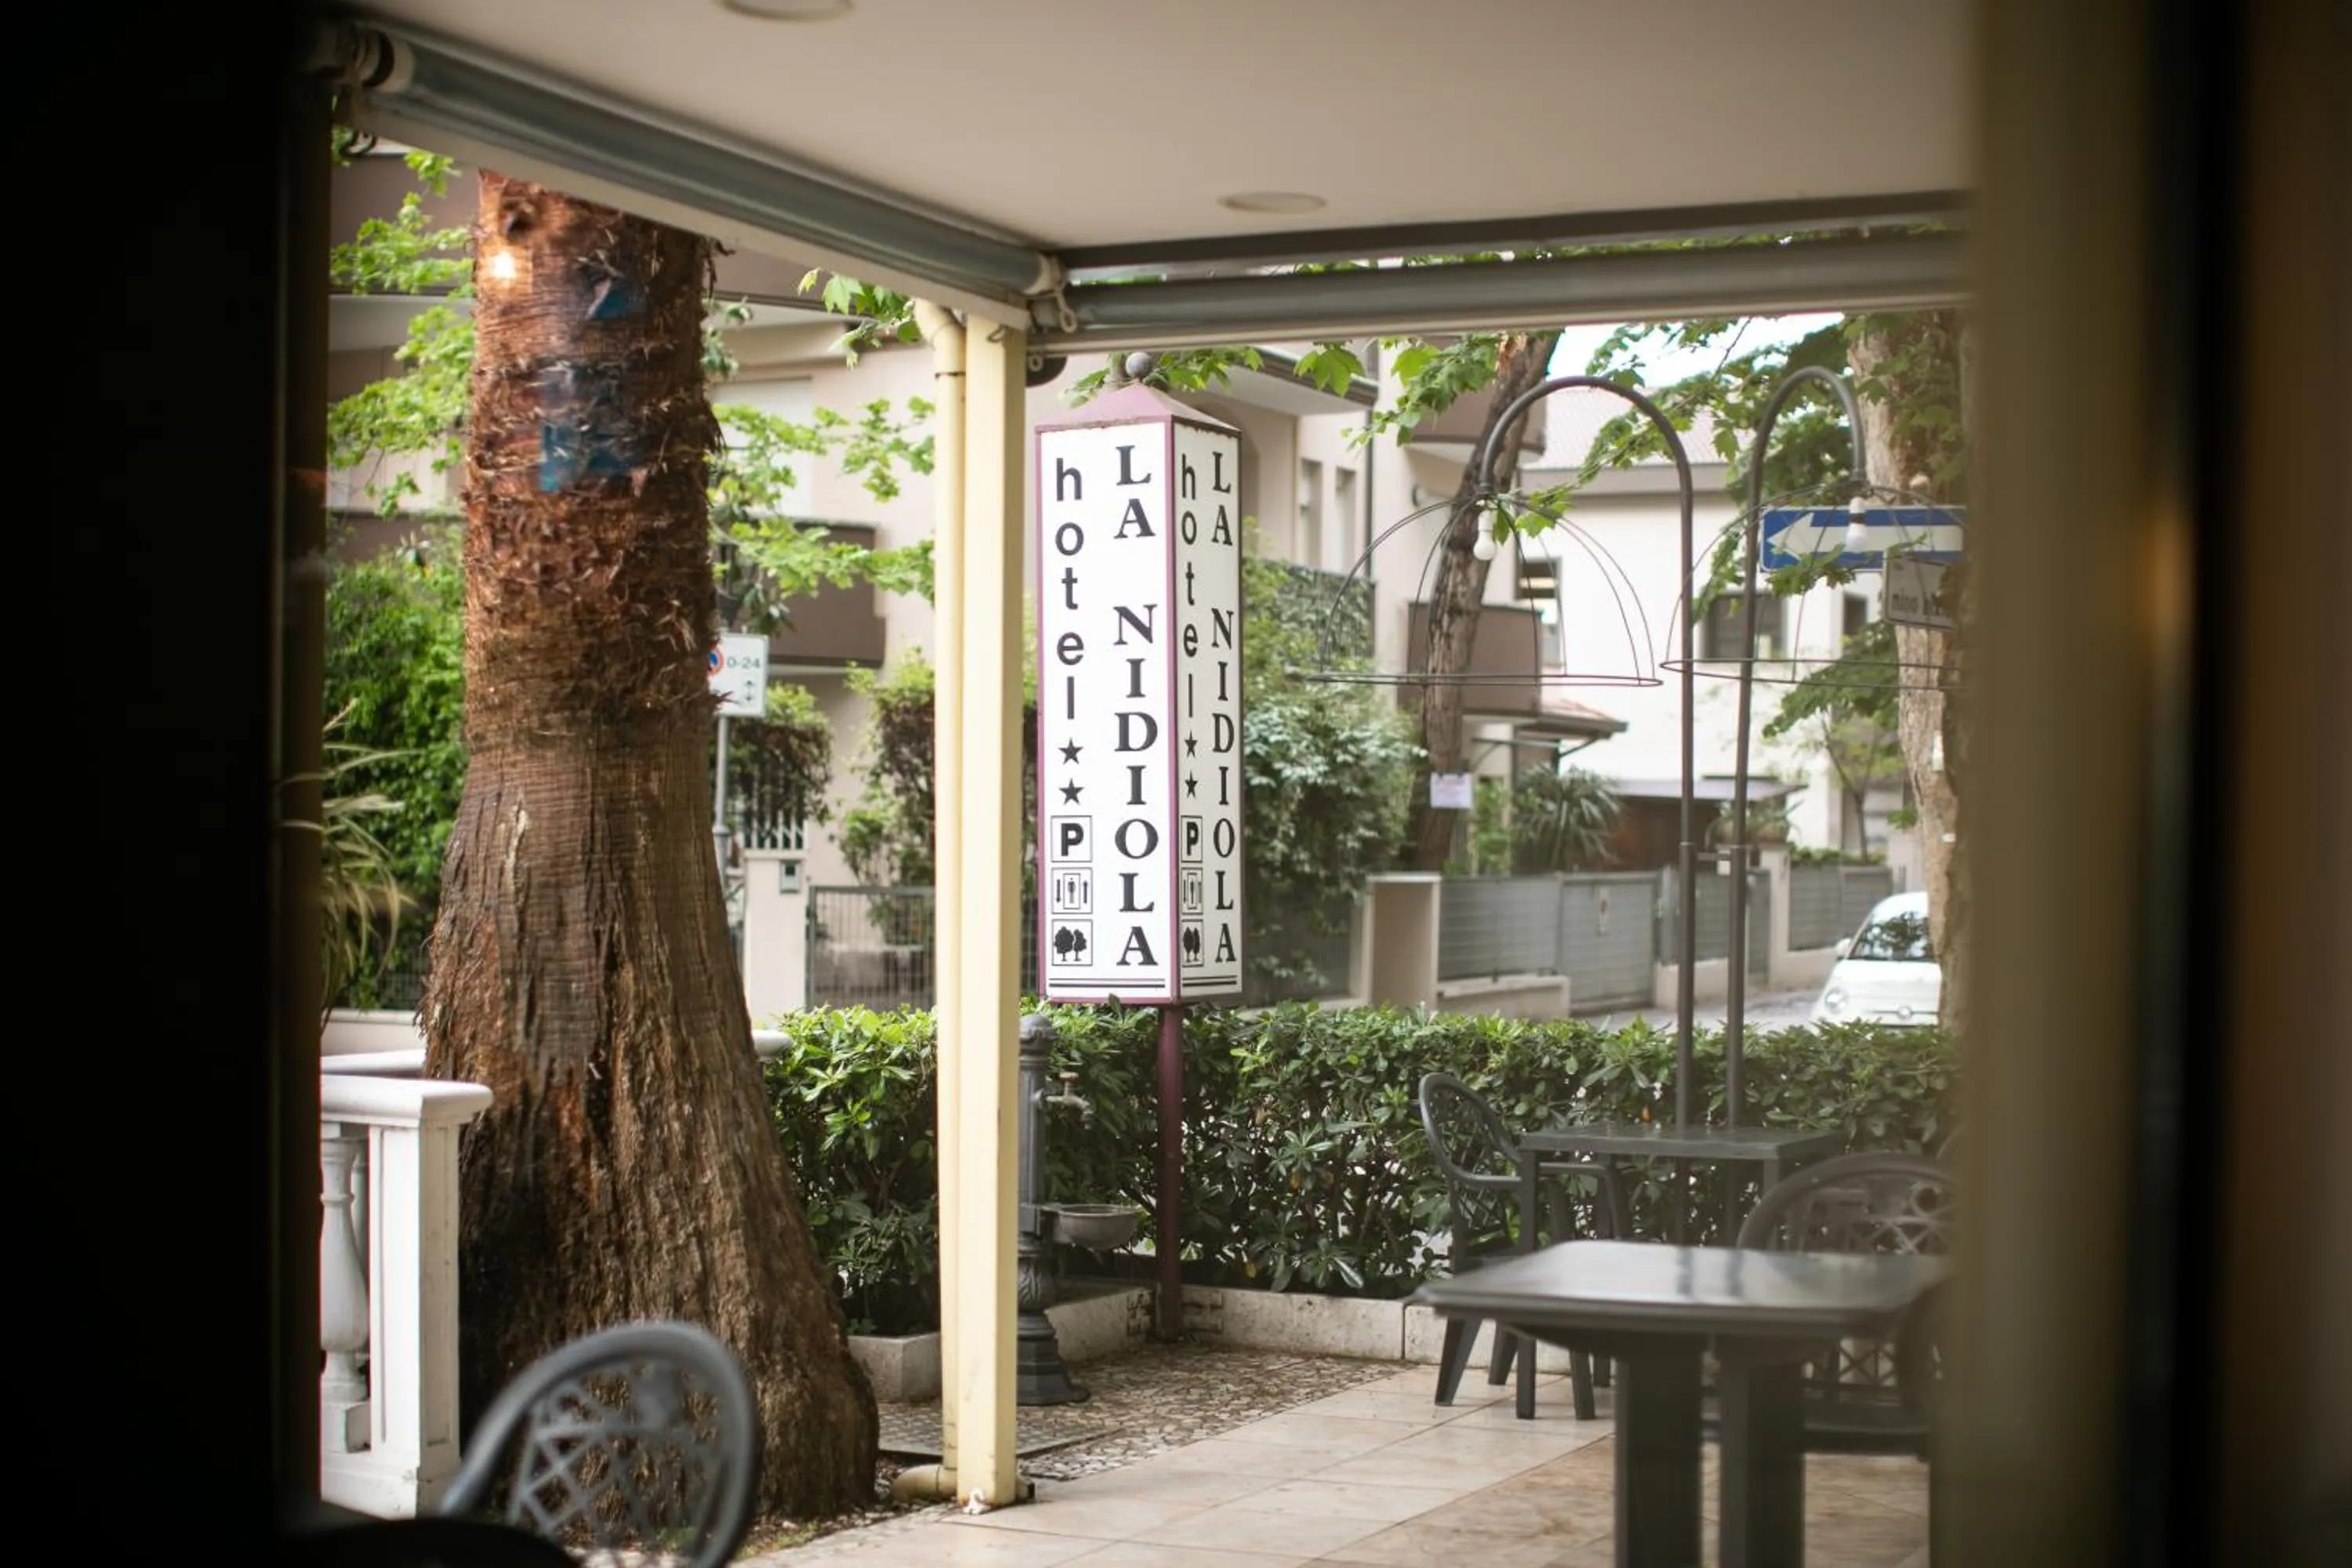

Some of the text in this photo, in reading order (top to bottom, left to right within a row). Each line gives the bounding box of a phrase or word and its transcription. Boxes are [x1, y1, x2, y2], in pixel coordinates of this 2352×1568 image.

[1055, 458, 1084, 720] hotel
[1113, 445, 1159, 966] LA NIDIOLA
[1181, 453, 1198, 717] hotel
[1211, 451, 1236, 963] LA NIDIOLA
[1061, 822, 1084, 857] P
[1186, 821, 1199, 856] P
